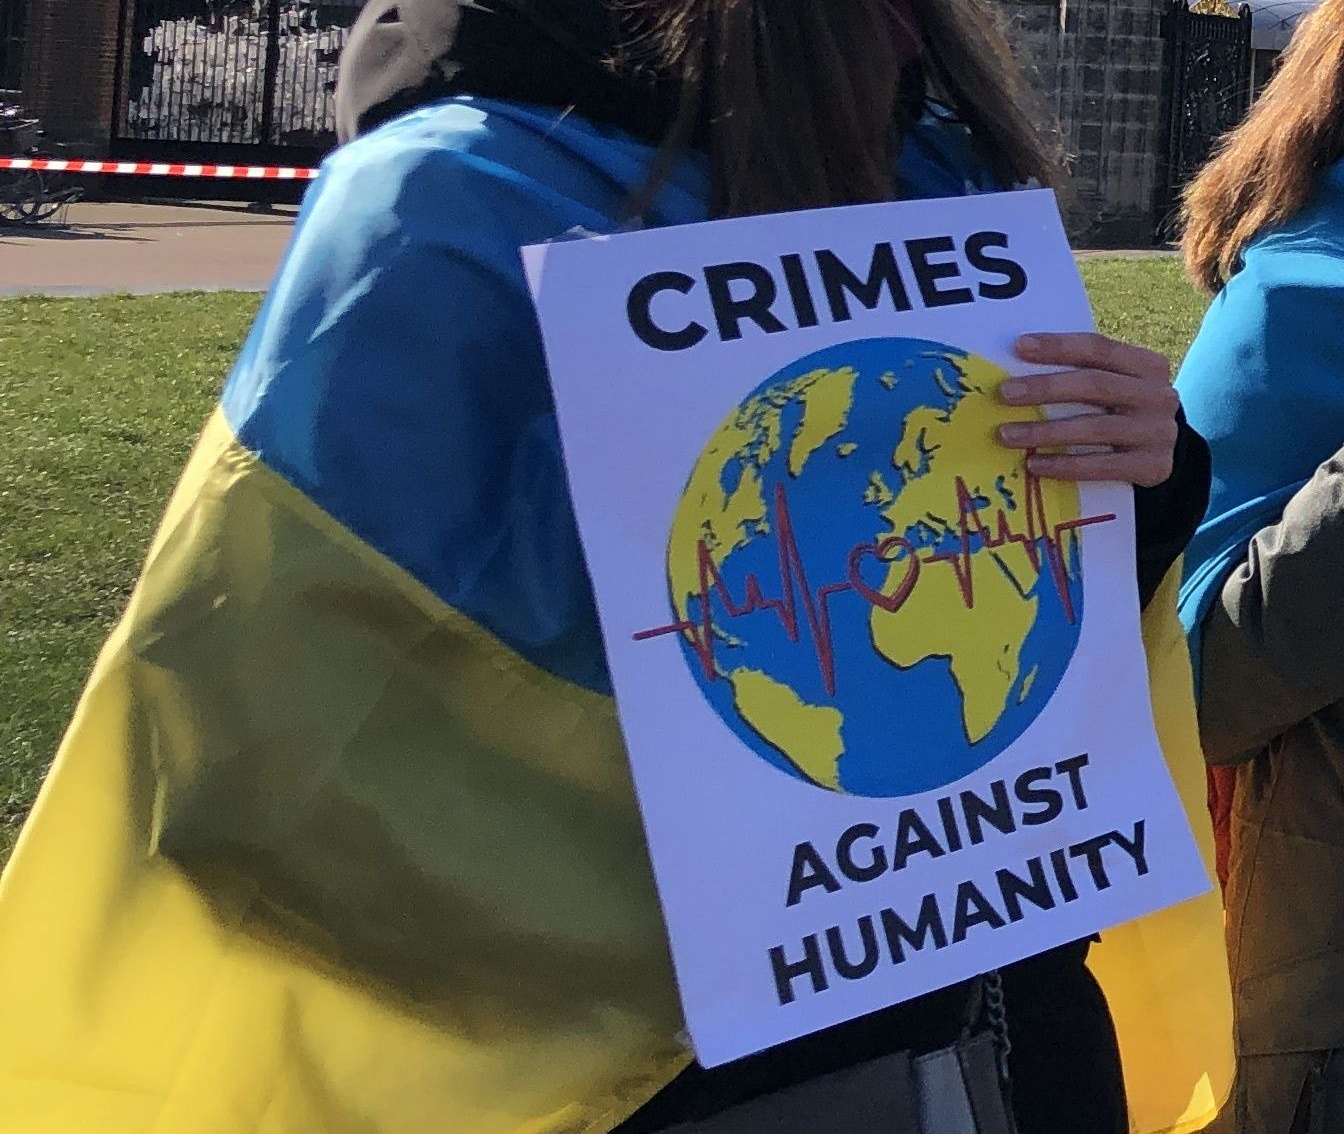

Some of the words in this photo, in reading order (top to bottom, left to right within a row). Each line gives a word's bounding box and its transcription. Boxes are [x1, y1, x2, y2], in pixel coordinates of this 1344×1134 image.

[627, 230, 1028, 353] CRIMES
[784, 753, 1090, 908] AGAINST
[767, 819, 1151, 1007] HUMANITY
